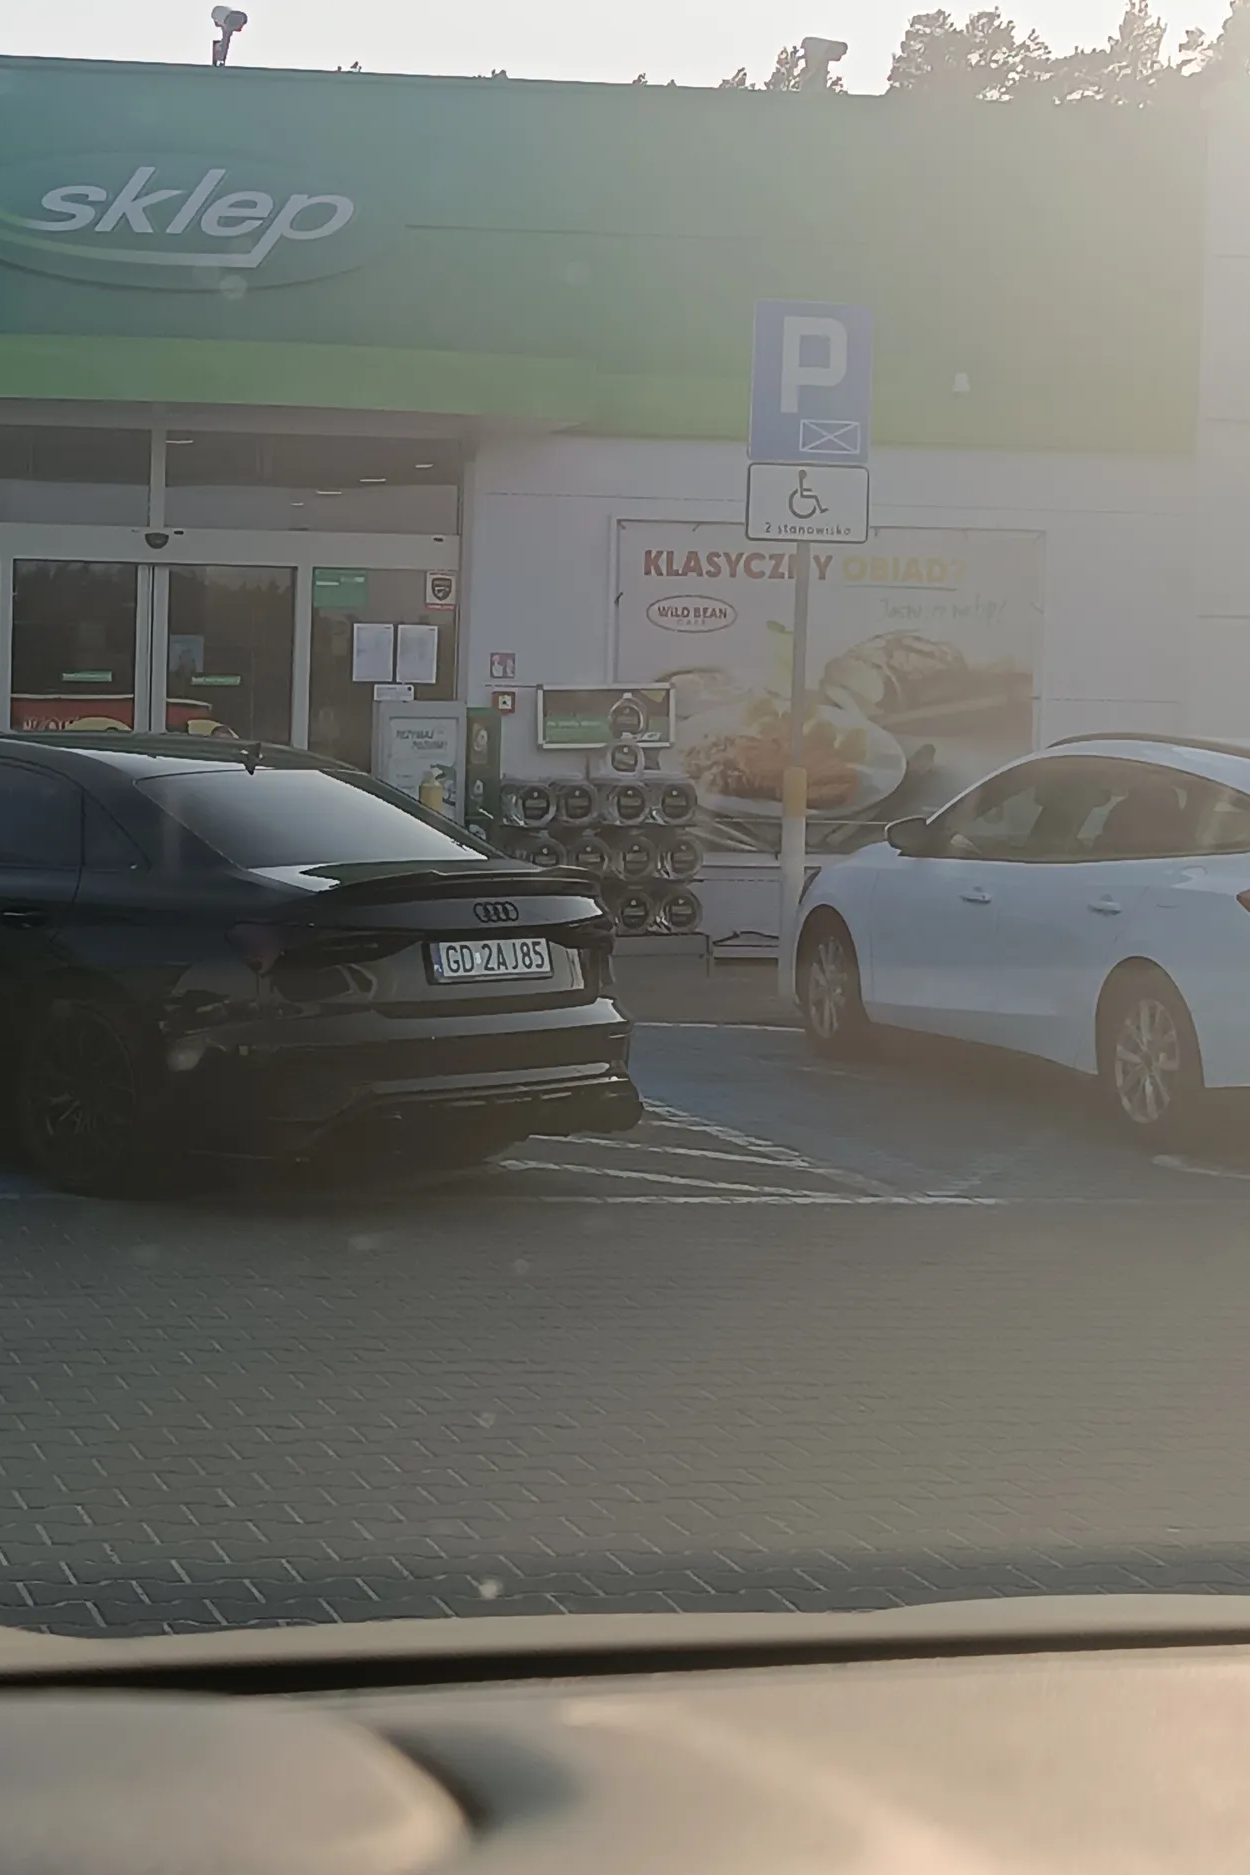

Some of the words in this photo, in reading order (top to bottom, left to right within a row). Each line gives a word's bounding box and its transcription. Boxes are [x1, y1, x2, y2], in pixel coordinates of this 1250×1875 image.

[25, 167, 354, 268] sklep
[780, 315, 848, 413] P
[765, 522, 771, 533] 2
[657, 606, 690, 618] WILD
[693, 607, 727, 619] BEAN
[446, 944, 474, 973] GD
[481, 941, 545, 971] 2AJ85
